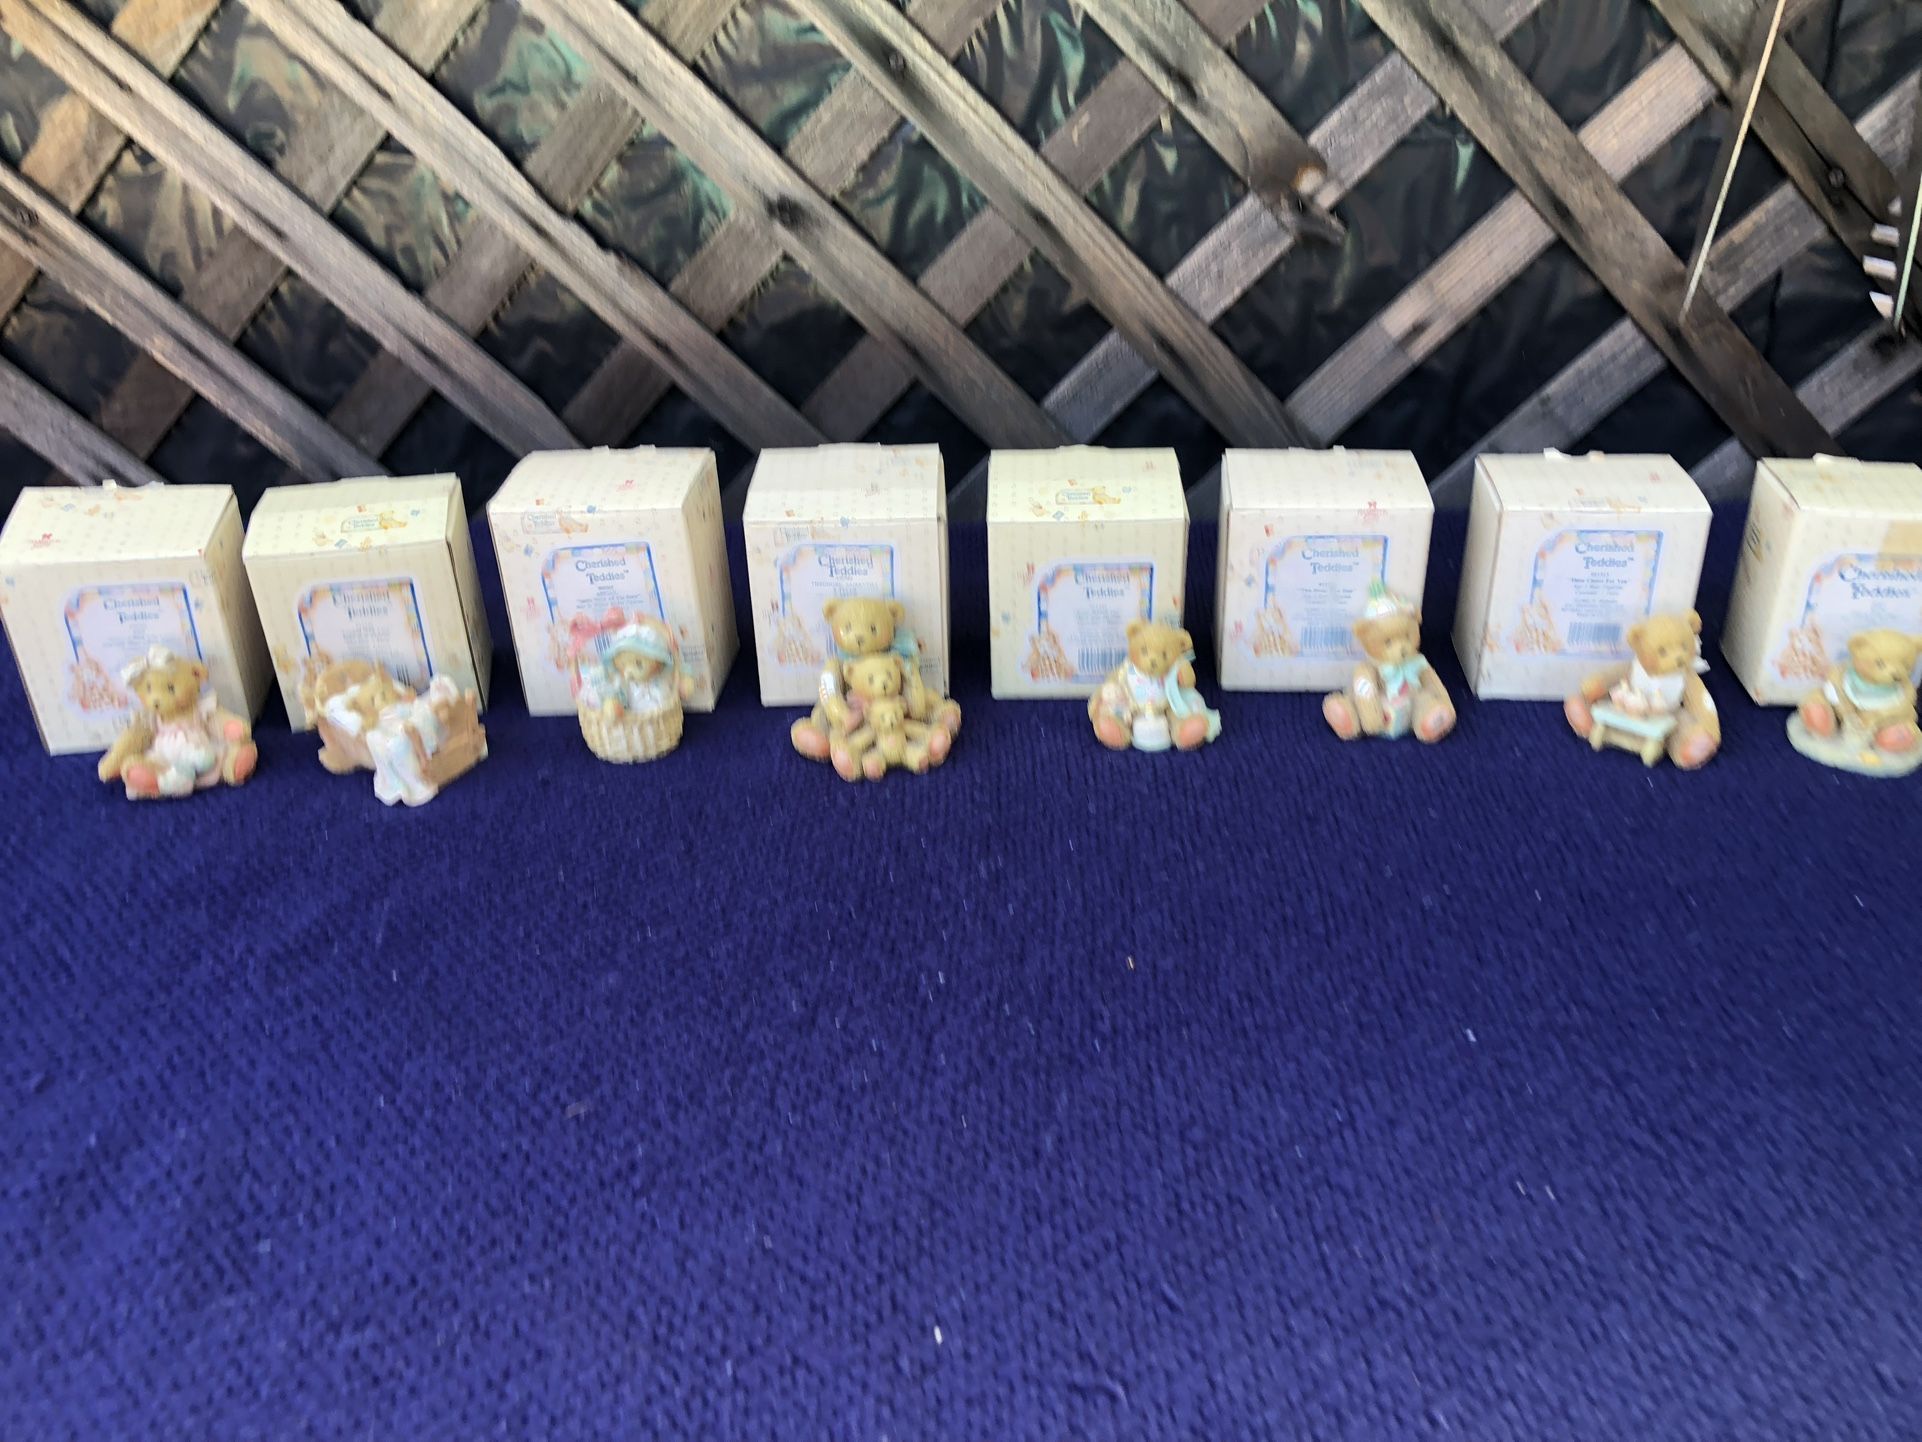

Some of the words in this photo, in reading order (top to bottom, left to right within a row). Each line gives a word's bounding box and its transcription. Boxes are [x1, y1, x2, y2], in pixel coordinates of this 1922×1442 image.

[1301, 545, 1360, 560] Cherished
[1574, 541, 1635, 554] Cherished
[575, 556, 627, 572] Cherished
[817, 550, 874, 569] Cherished
